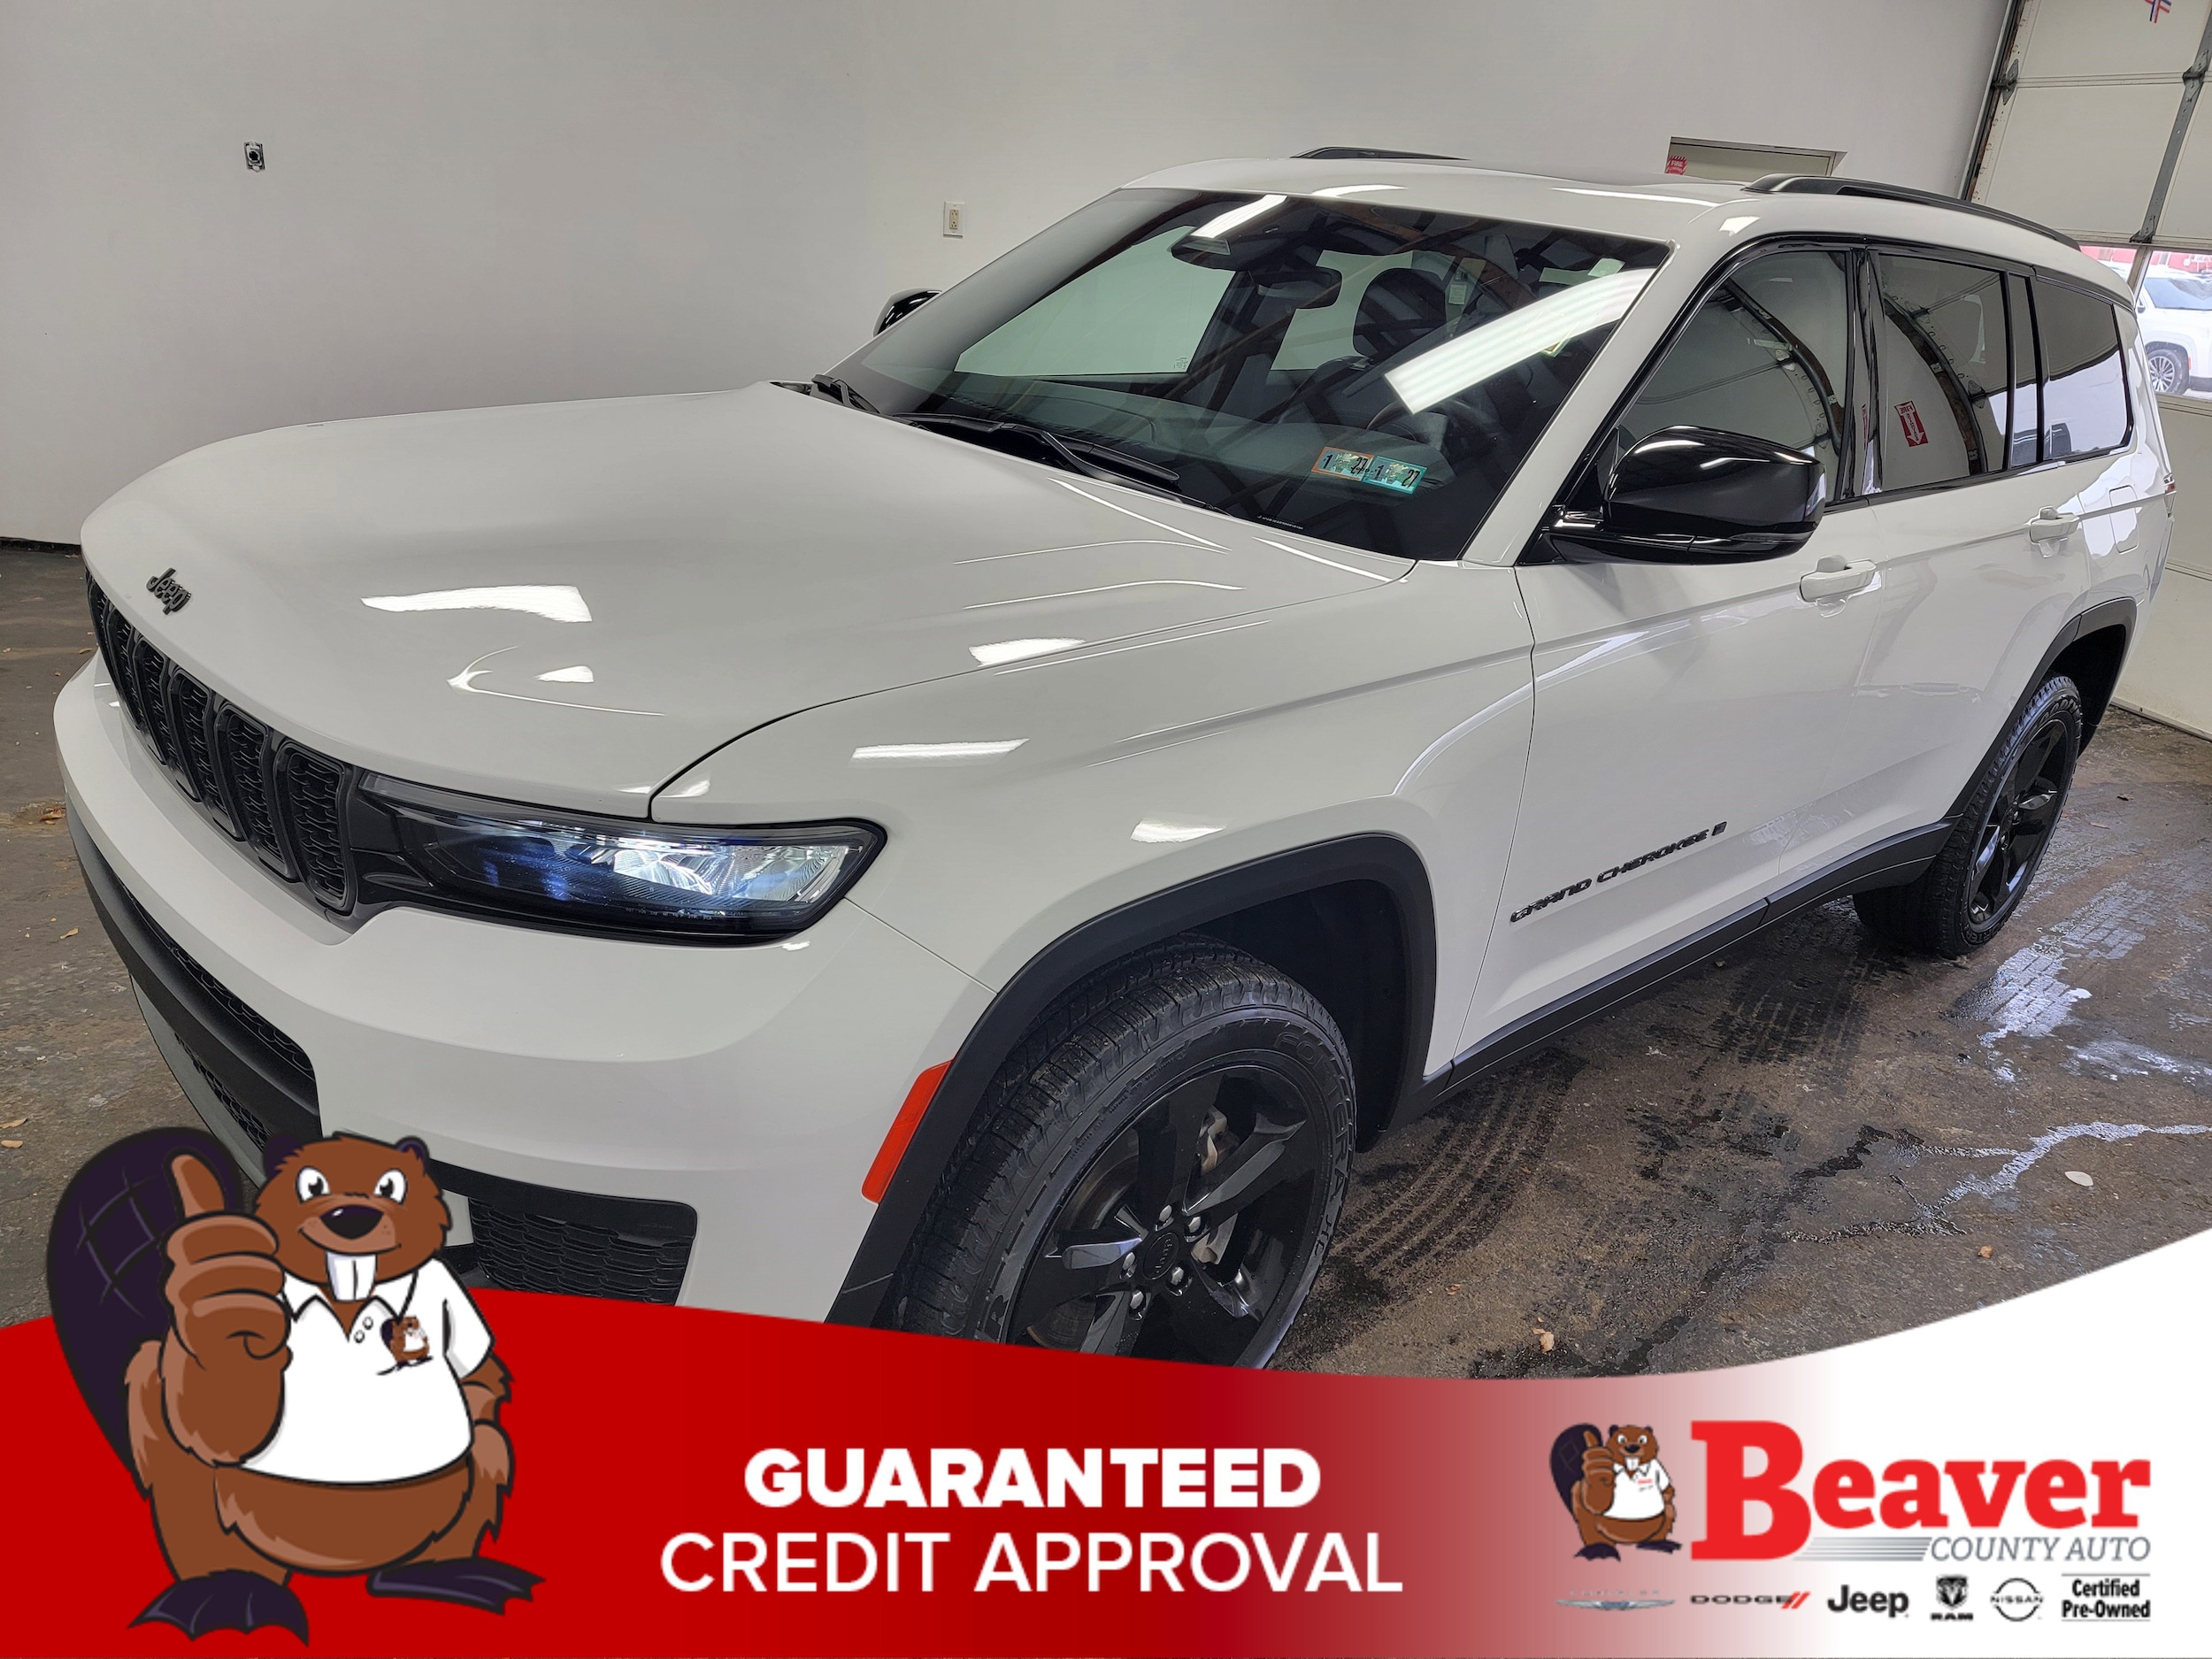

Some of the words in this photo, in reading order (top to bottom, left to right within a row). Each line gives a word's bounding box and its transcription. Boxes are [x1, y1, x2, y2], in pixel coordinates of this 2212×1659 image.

[1323, 454, 1333, 469] 1
[1402, 469, 1421, 488] 27
[146, 567, 192, 616] Jeep
[1509, 878, 1593, 923] GRAND
[1596, 828, 1710, 883] CHEROKEE
